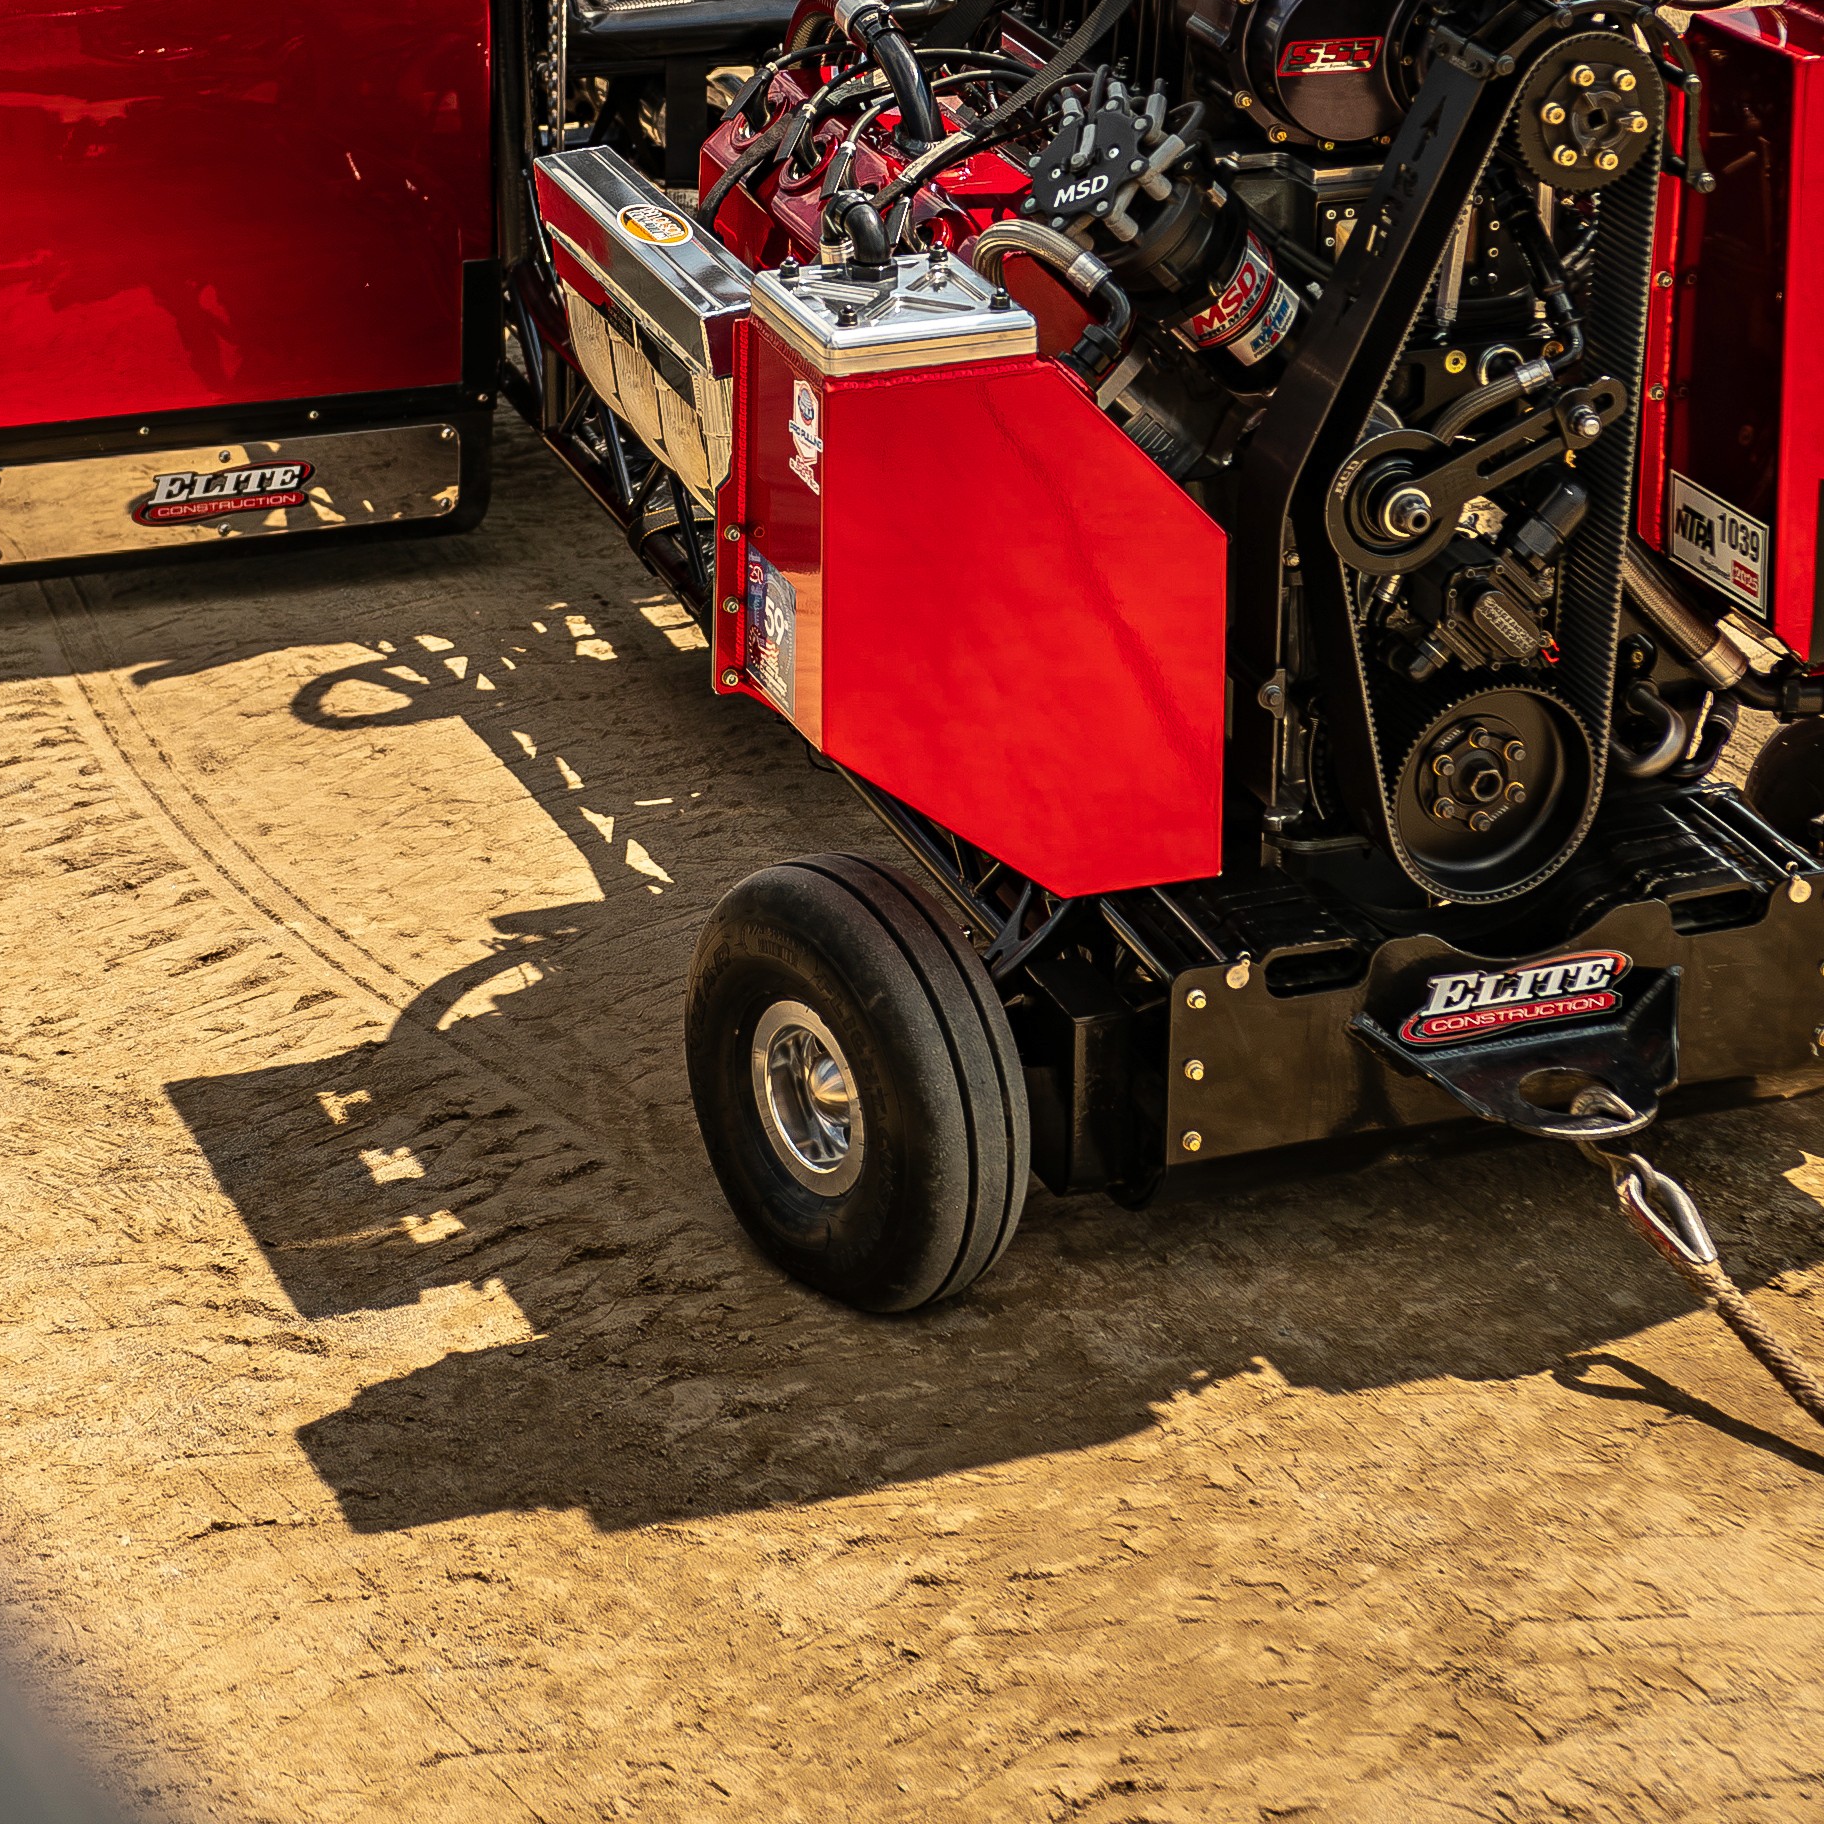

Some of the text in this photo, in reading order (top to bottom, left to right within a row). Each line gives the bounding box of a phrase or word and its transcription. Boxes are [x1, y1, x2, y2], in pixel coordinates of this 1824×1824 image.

[1053, 175, 1109, 208] MSD
[1192, 261, 1257, 336] MSD
[147, 464, 301, 507] ELITE
[157, 492, 297, 519] CONSTRUCTION
[1717, 511, 1761, 564] 1039
[1421, 958, 1615, 1017] ELITE
[1430, 995, 1606, 1033] CONSTRUCTION
